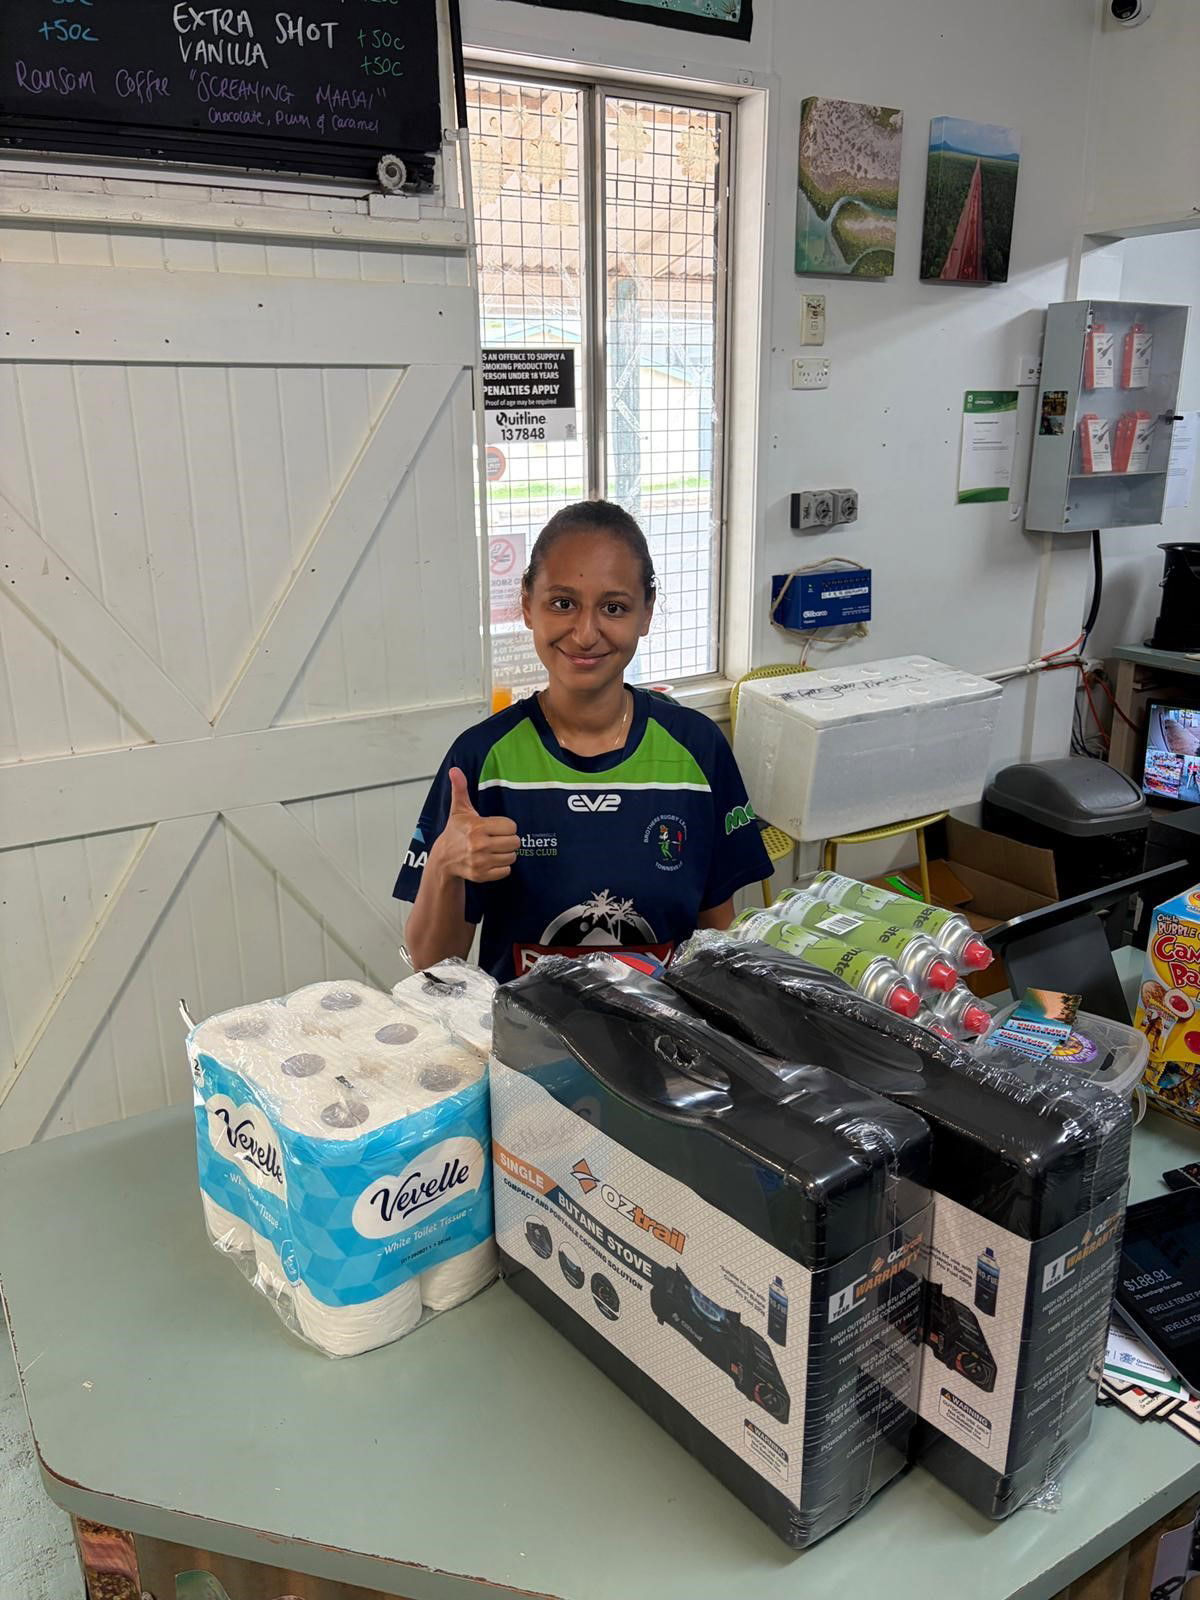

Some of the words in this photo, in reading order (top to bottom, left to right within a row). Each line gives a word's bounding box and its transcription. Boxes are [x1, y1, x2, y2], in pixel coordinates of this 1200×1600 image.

[38, 19, 99, 41] +50c
[173, 2, 254, 39] EXTRA
[275, 12, 340, 49] SHOT
[357, 28, 406, 51] +50c
[178, 35, 269, 70] VANILLA
[360, 56, 405, 77] +50c
[15, 59, 97, 95] Ransom
[115, 68, 172, 105] Coffee
[275, 110, 311, 129] Plum
[331, 115, 380, 135] Caramel
[498, 353, 527, 361] OFFENCE
[526, 353, 536, 361] TO
[536, 353, 560, 361] SUPPLY
[560, 353, 566, 361] A
[513, 362, 543, 370] PRODUCT
[543, 362, 553, 370] TO
[553, 362, 559, 370] A
[507, 371, 530, 380] UNDER
[530, 371, 539, 379] 18
[539, 371, 560, 380] YEARS
[483, 384, 531, 396] PENALTIES
[531, 384, 560, 395] APPLY
[506, 399, 516, 408] age
[516, 399, 528, 407] may
[495, 410, 547, 427] Quitline
[660, 814, 679, 822] RUGBY
[520, 834, 558, 848] thers
[535, 848, 558, 857] CLUB
[215, 1108, 283, 1184] Vevelle
[369, 1158, 470, 1222] Vevelle
[500, 1152, 545, 1189] SINGLE
[558, 1191, 605, 1242] BUTANE
[606, 1235, 653, 1278] STOVE
[383, 1237, 412, 1256] White
[413, 1223, 438, 1241] Toilet
[440, 1209, 468, 1228] Tissue
[503, 1177, 536, 1202] COMPACT
[535, 1198, 550, 1211] AND
[549, 1207, 580, 1238] PORTABLE
[578, 1234, 607, 1264] COOKING
[606, 1259, 643, 1292] SOLUTION
[855, 1248, 920, 1298] WARRANTY
[1123, 1268, 1173, 1292] $188.91
[832, 1304, 851, 1320] YEAR
[838, 1292, 847, 1310] 1
[1145, 1299, 1175, 1315] VEVELLE
[1161, 1317, 1192, 1334] VEVELLE
[952, 1396, 989, 1427] WARNING
[754, 1426, 787, 1460] WARNING
